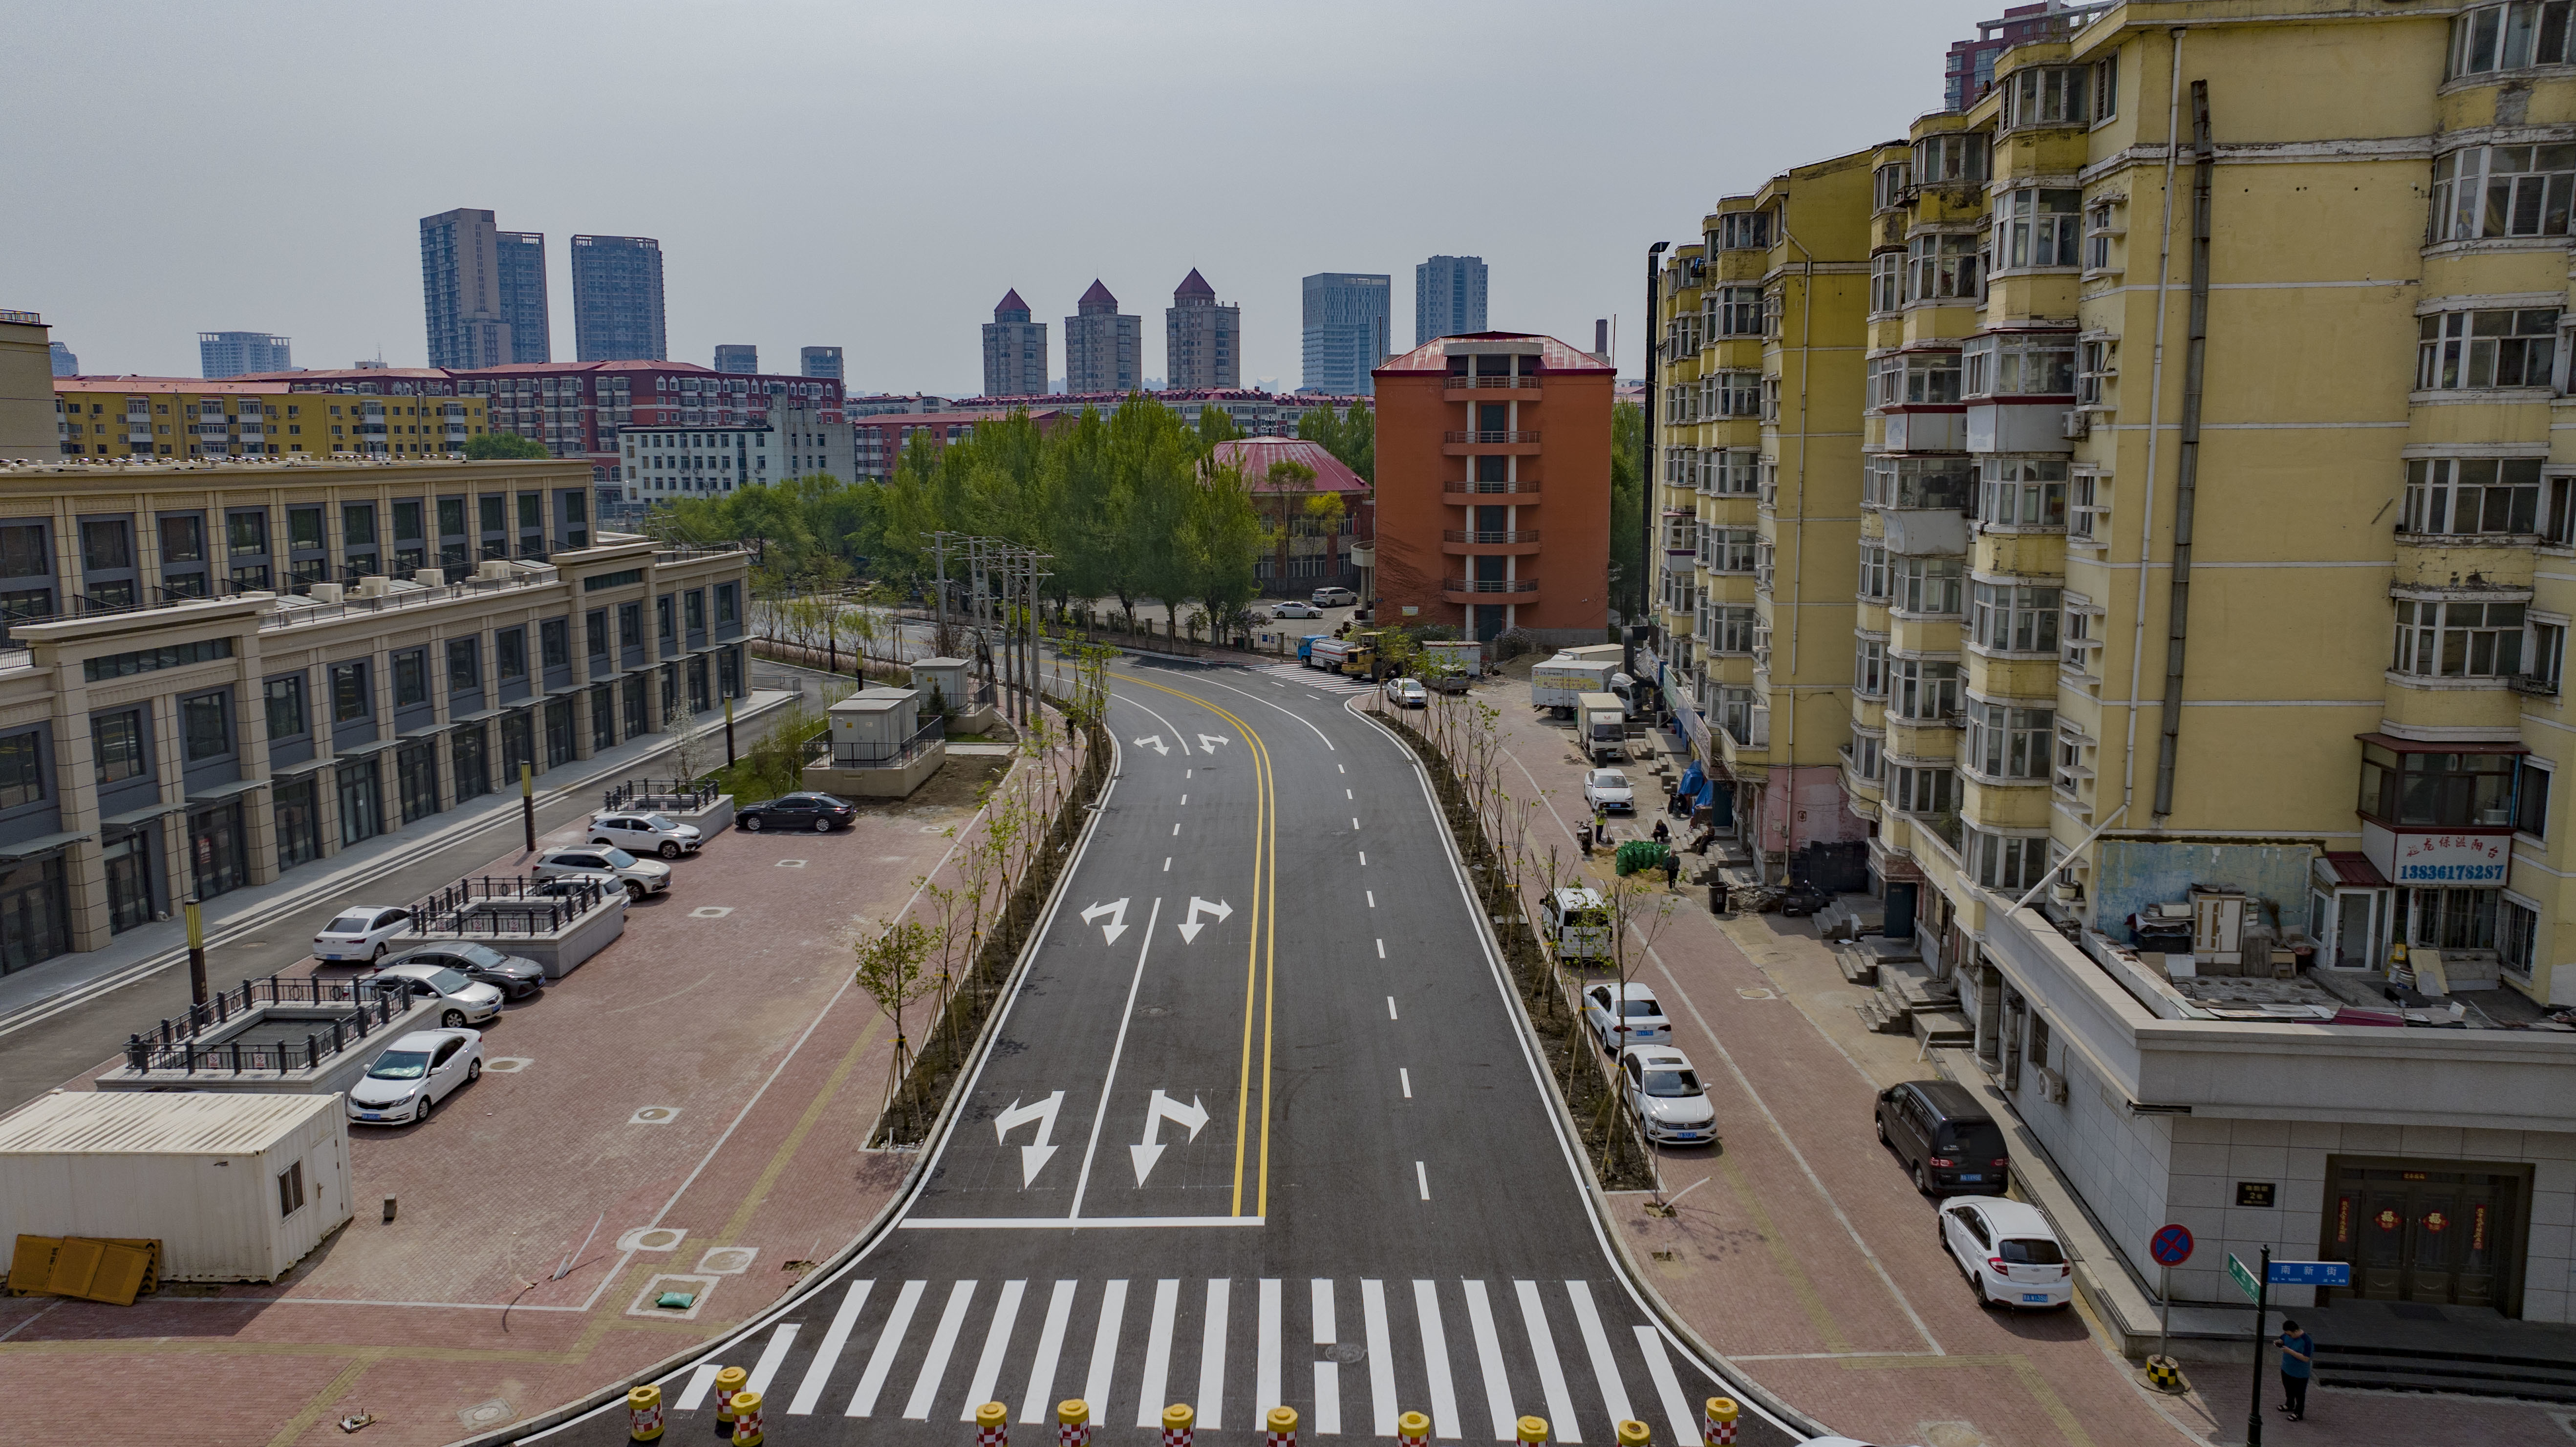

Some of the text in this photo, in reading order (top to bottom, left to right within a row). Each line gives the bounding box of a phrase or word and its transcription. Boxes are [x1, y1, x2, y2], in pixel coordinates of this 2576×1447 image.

[2400, 865, 2504, 880] 13836178287
[2281, 1265, 2337, 1276] 南新街
